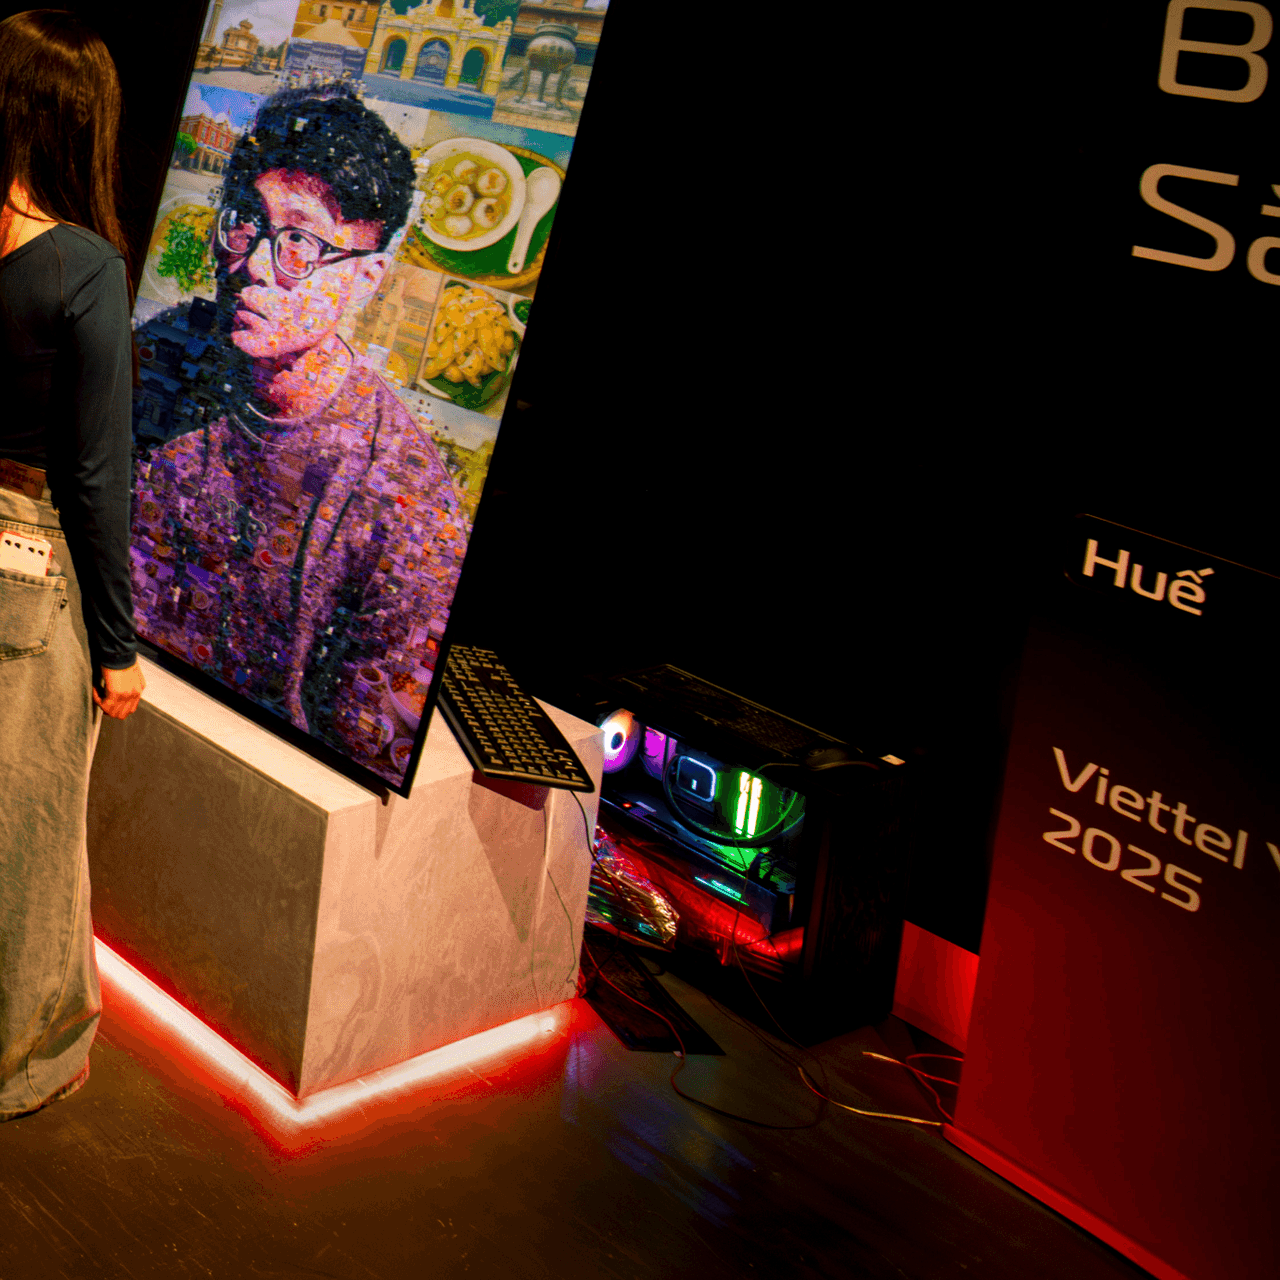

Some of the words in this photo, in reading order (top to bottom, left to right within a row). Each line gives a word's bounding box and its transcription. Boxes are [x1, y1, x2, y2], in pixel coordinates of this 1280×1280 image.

[1082, 538, 1216, 617] Huế
[1040, 806, 1203, 912] 2025
[1051, 745, 1248, 870] Viettel
